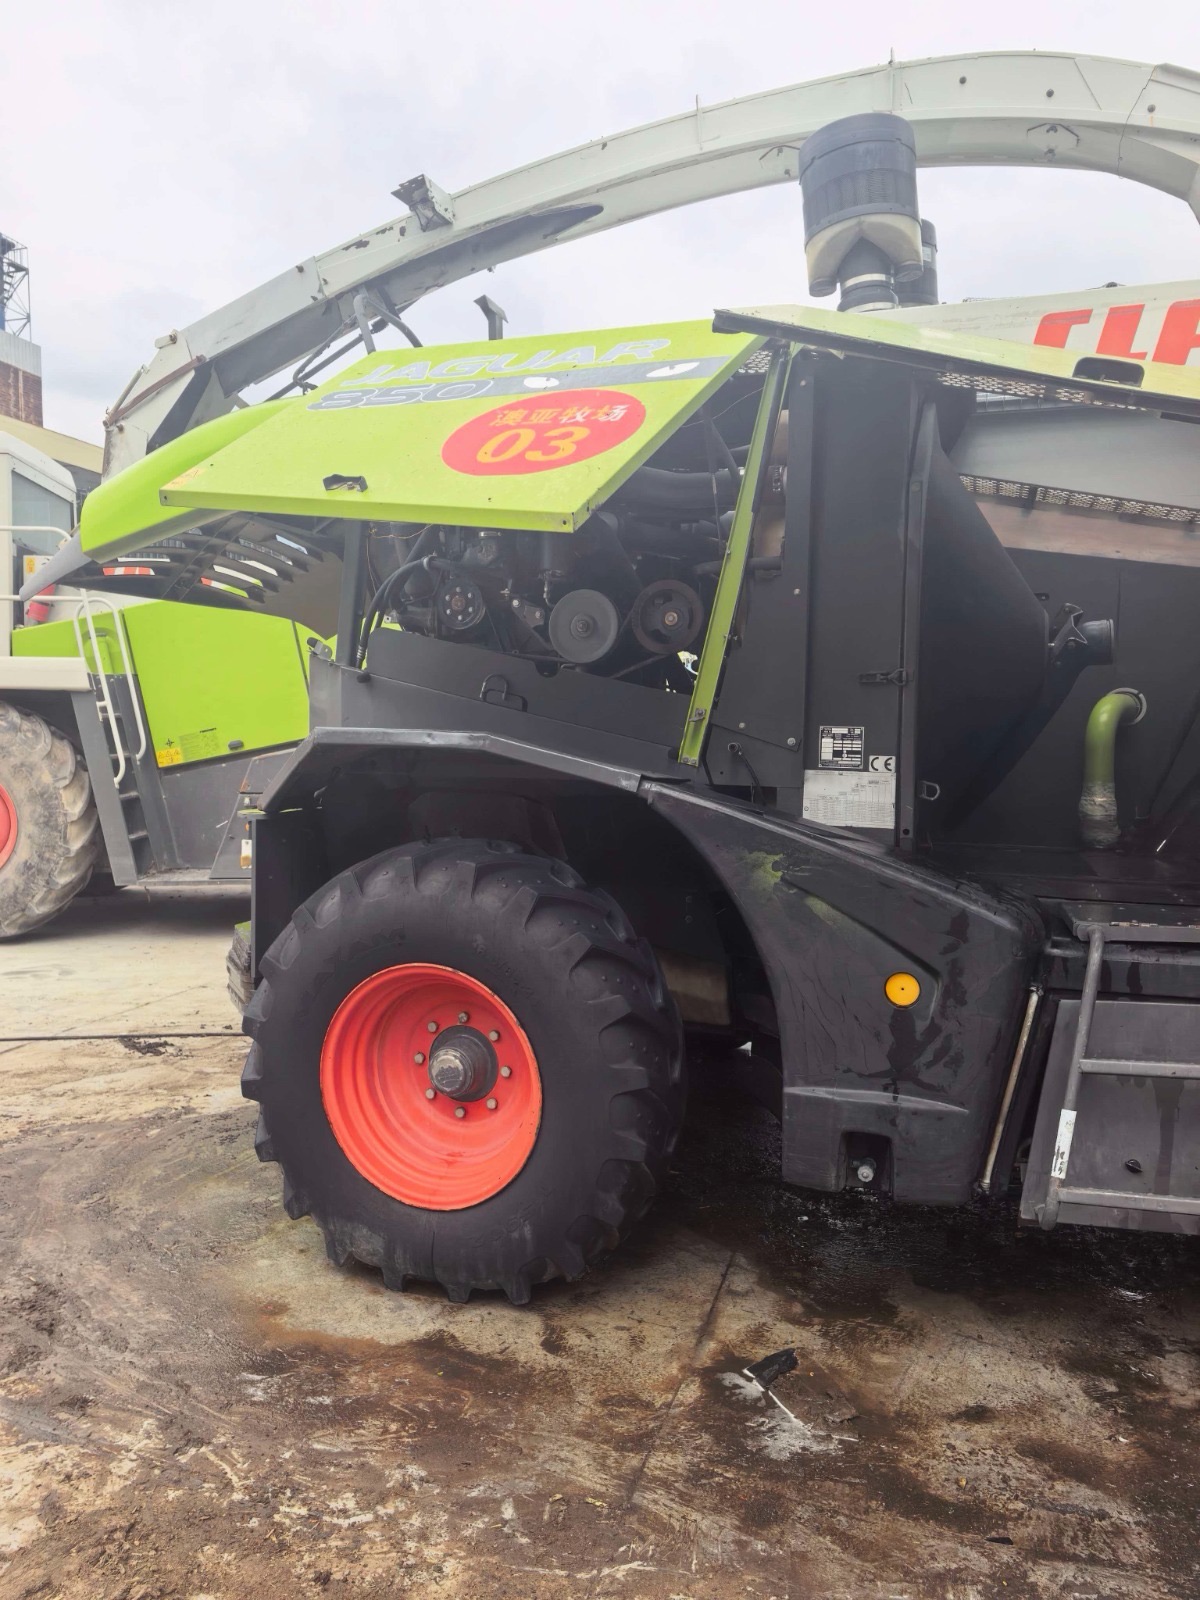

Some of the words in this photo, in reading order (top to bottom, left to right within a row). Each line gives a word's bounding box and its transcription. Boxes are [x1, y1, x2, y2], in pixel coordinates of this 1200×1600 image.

[340, 338, 671, 386] JAGUAR
[306, 379, 494, 411] 850
[490, 403, 630, 427] 澳亚牧场
[476, 426, 591, 464] 03
[870, 756, 893, 772] CE
